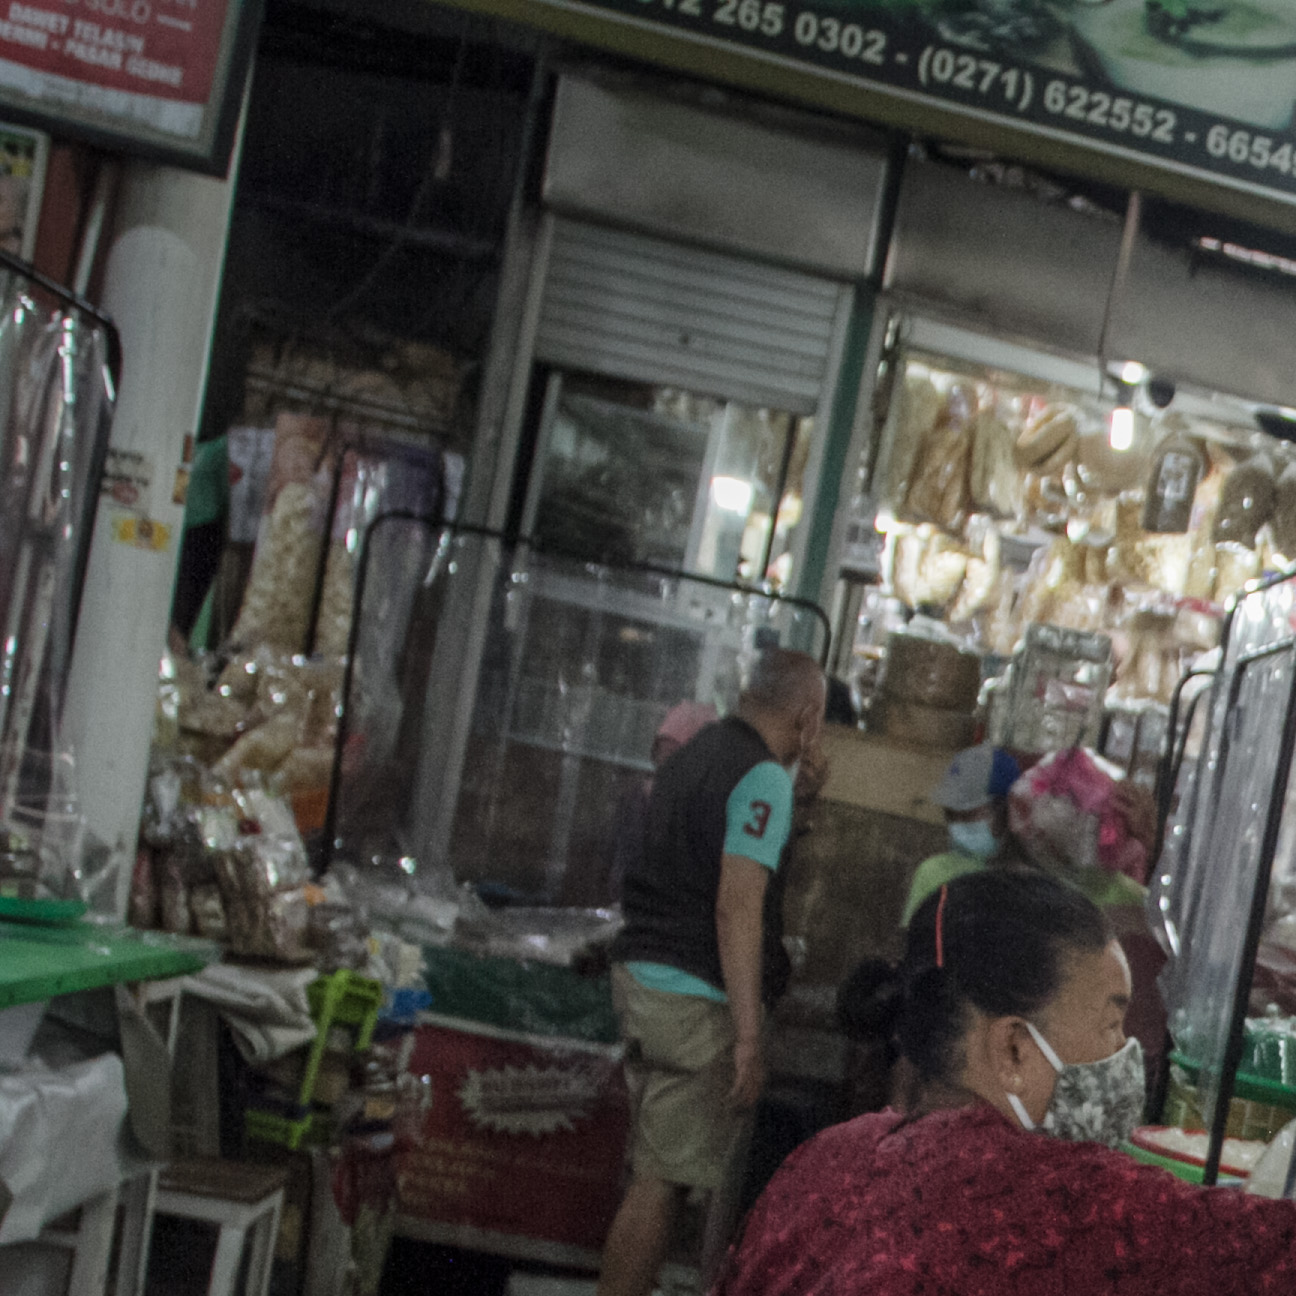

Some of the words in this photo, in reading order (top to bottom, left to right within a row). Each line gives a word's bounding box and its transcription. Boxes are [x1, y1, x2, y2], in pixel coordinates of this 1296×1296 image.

[713, 0, 785, 37] 265
[794, 12, 886, 65] 0302
[918, 45, 1034, 110] (0271)
[1043, 80, 1178, 144] 622552
[743, 800, 772, 840] 3
